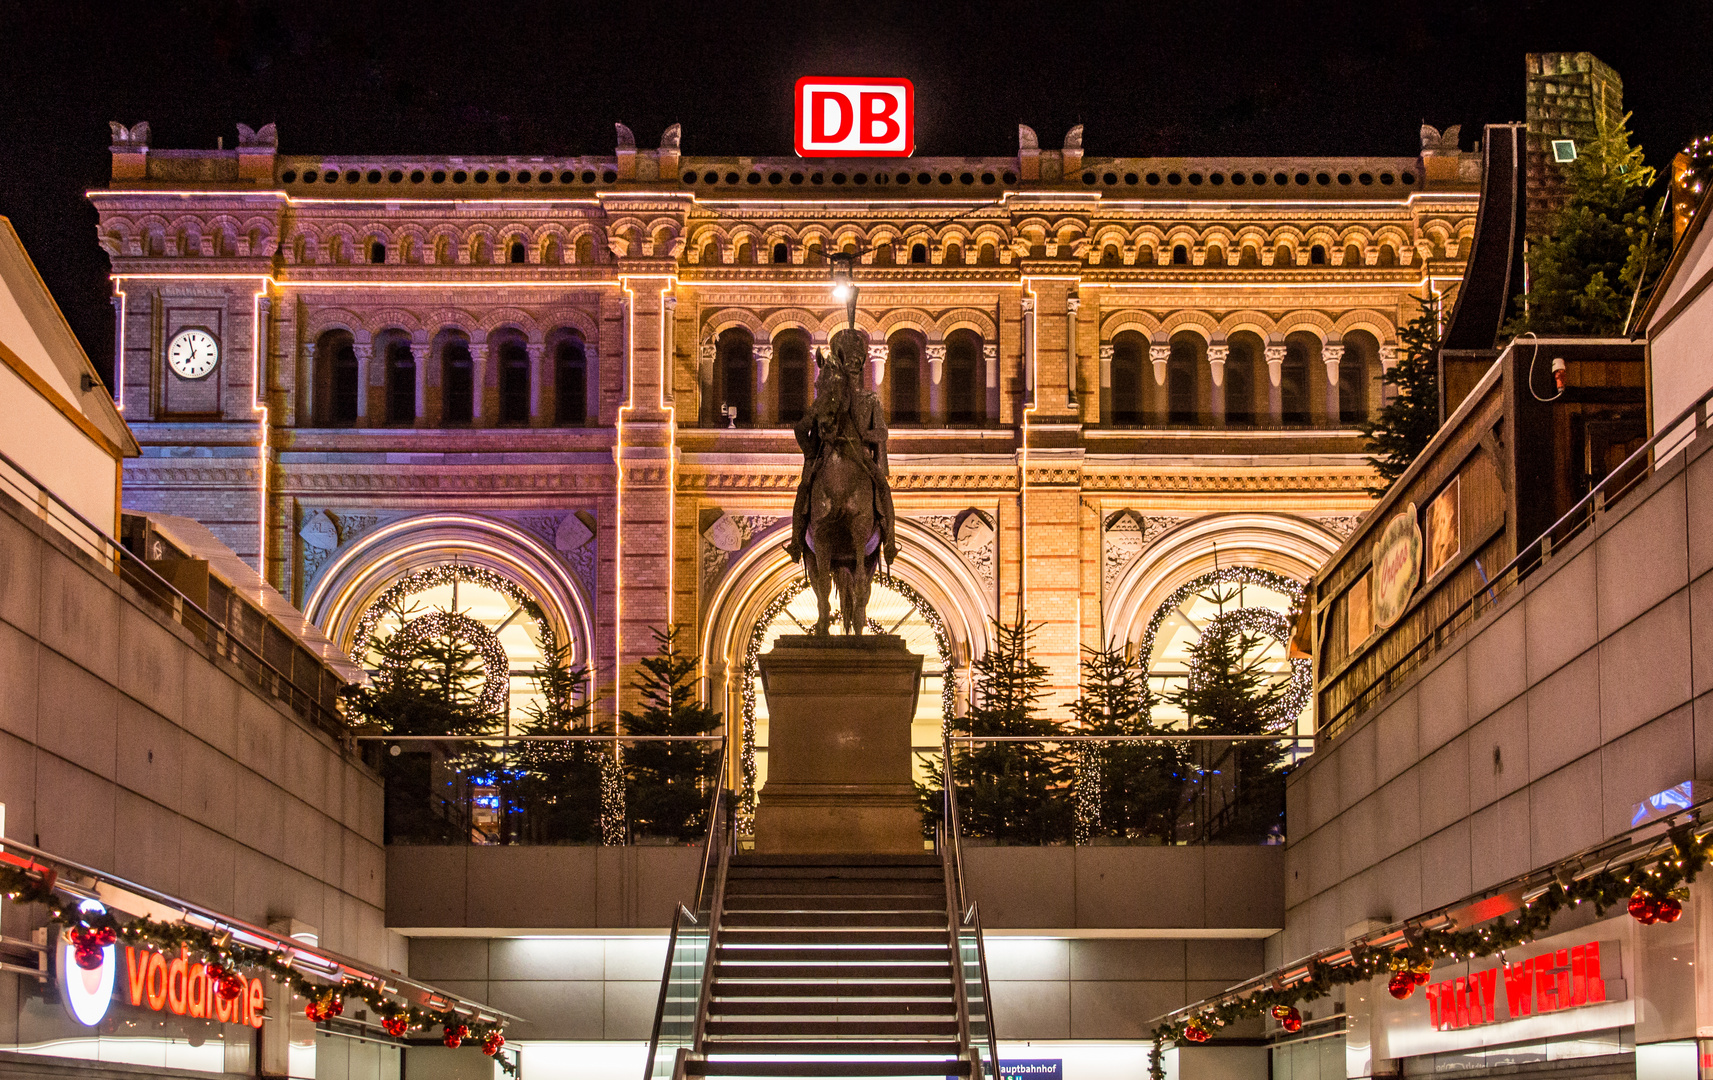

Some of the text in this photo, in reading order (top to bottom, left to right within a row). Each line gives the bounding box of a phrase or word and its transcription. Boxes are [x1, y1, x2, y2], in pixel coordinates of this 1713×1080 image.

[811, 91, 901, 145] DB
[1425, 967, 1498, 1032] TALLY
[998, 1063, 1057, 1076] auptbahnhof
